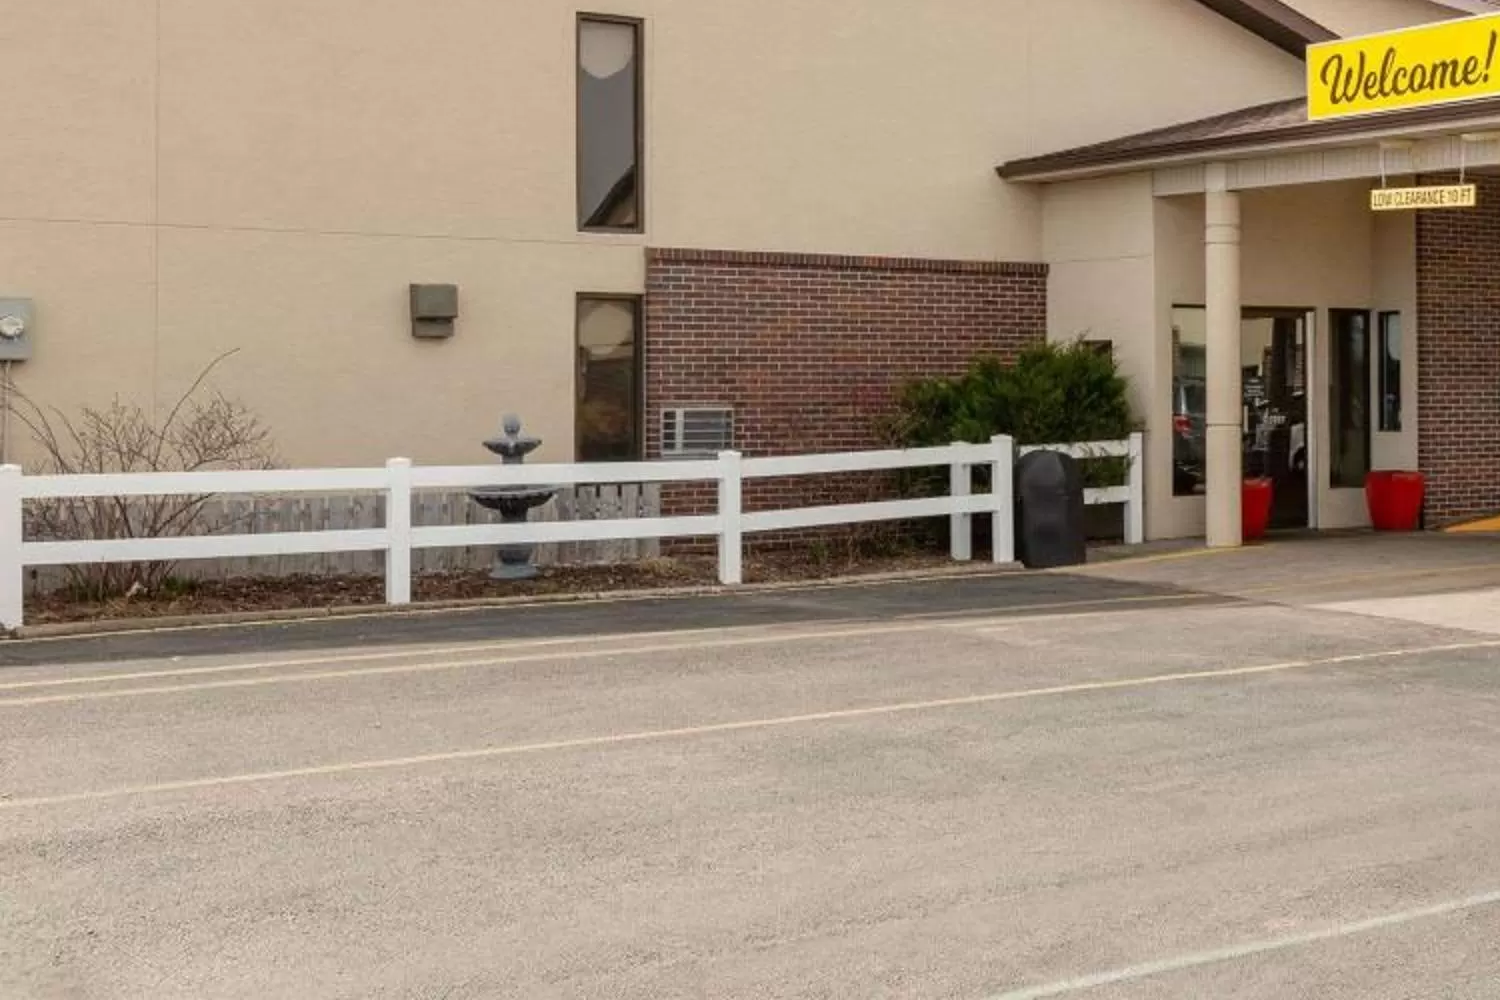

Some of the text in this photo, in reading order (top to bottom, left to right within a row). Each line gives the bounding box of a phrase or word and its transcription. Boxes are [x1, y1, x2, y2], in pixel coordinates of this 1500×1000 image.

[1320, 30, 1498, 104] Welcome!
[1373, 191, 1392, 207] LOW
[1395, 189, 1444, 206] CLEARANCE
[1460, 187, 1472, 203] FT
